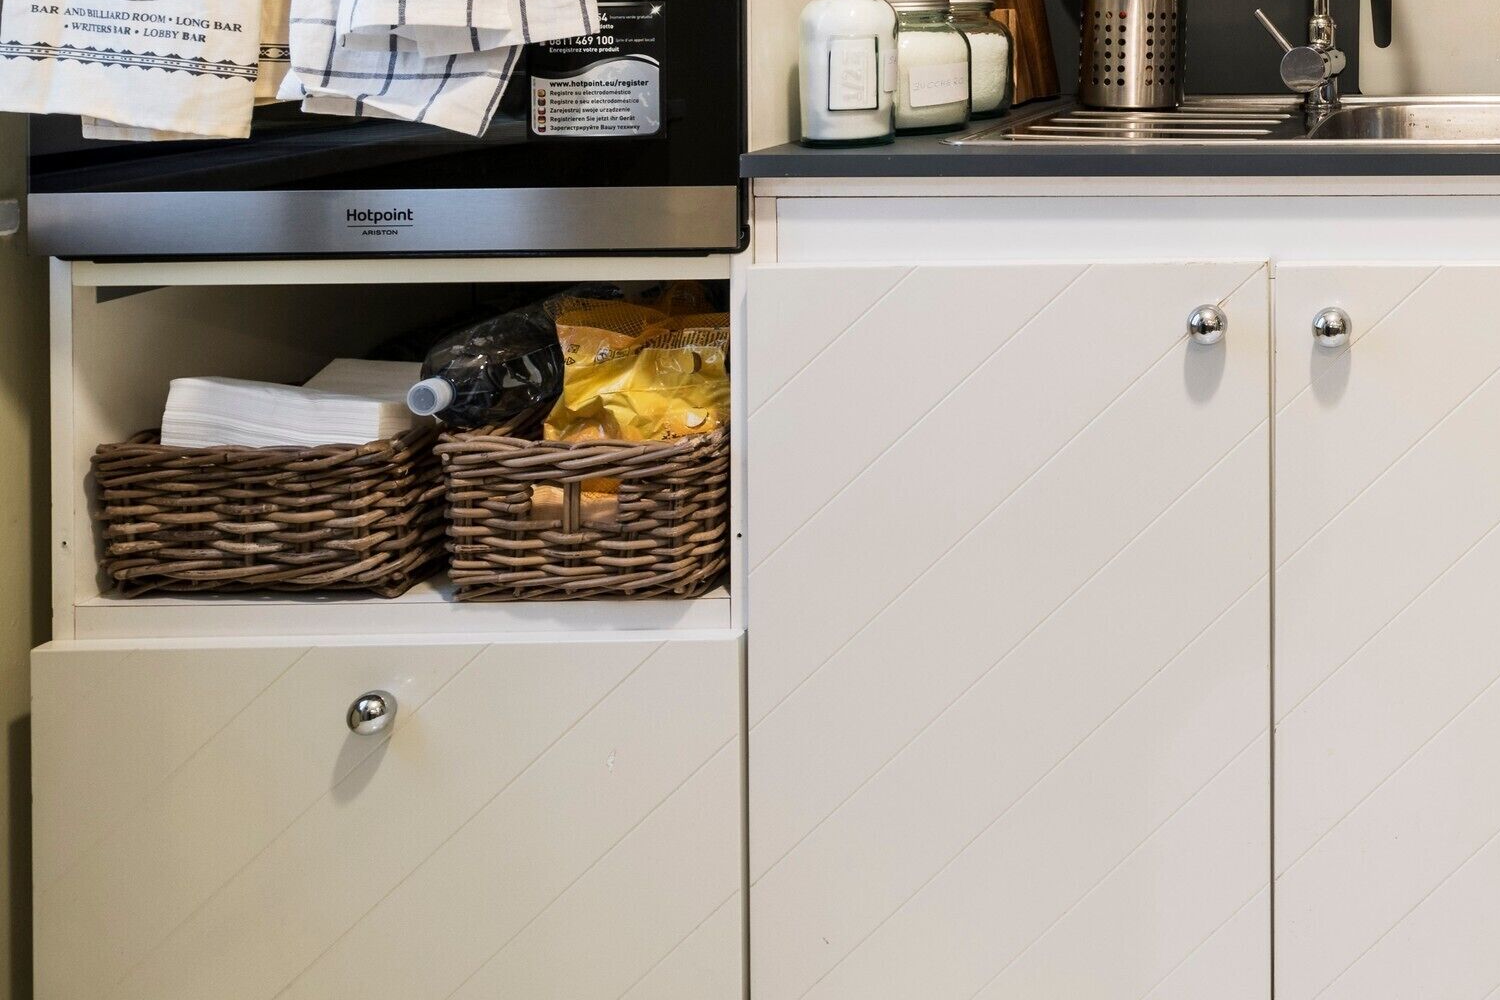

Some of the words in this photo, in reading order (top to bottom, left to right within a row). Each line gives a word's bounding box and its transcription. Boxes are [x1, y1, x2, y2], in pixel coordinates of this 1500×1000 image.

[31, 4, 59, 15] BAR
[64, 7, 86, 17] AND
[87, 9, 130, 21] BILLIARD
[132, 12, 166, 24] ROOM
[175, 16, 210, 29] LONG
[214, 21, 243, 33] BAR
[71, 22, 112, 34] WRITERS
[143, 27, 179, 39] LOBBY
[182, 31, 207, 43] BAR
[576, 36, 594, 46] 469
[596, 36, 614, 45] 100
[599, 46, 620, 54] produit
[549, 79, 649, 88] www.hotpoint.eu/register
[346, 208, 414, 225] Hotpoint
